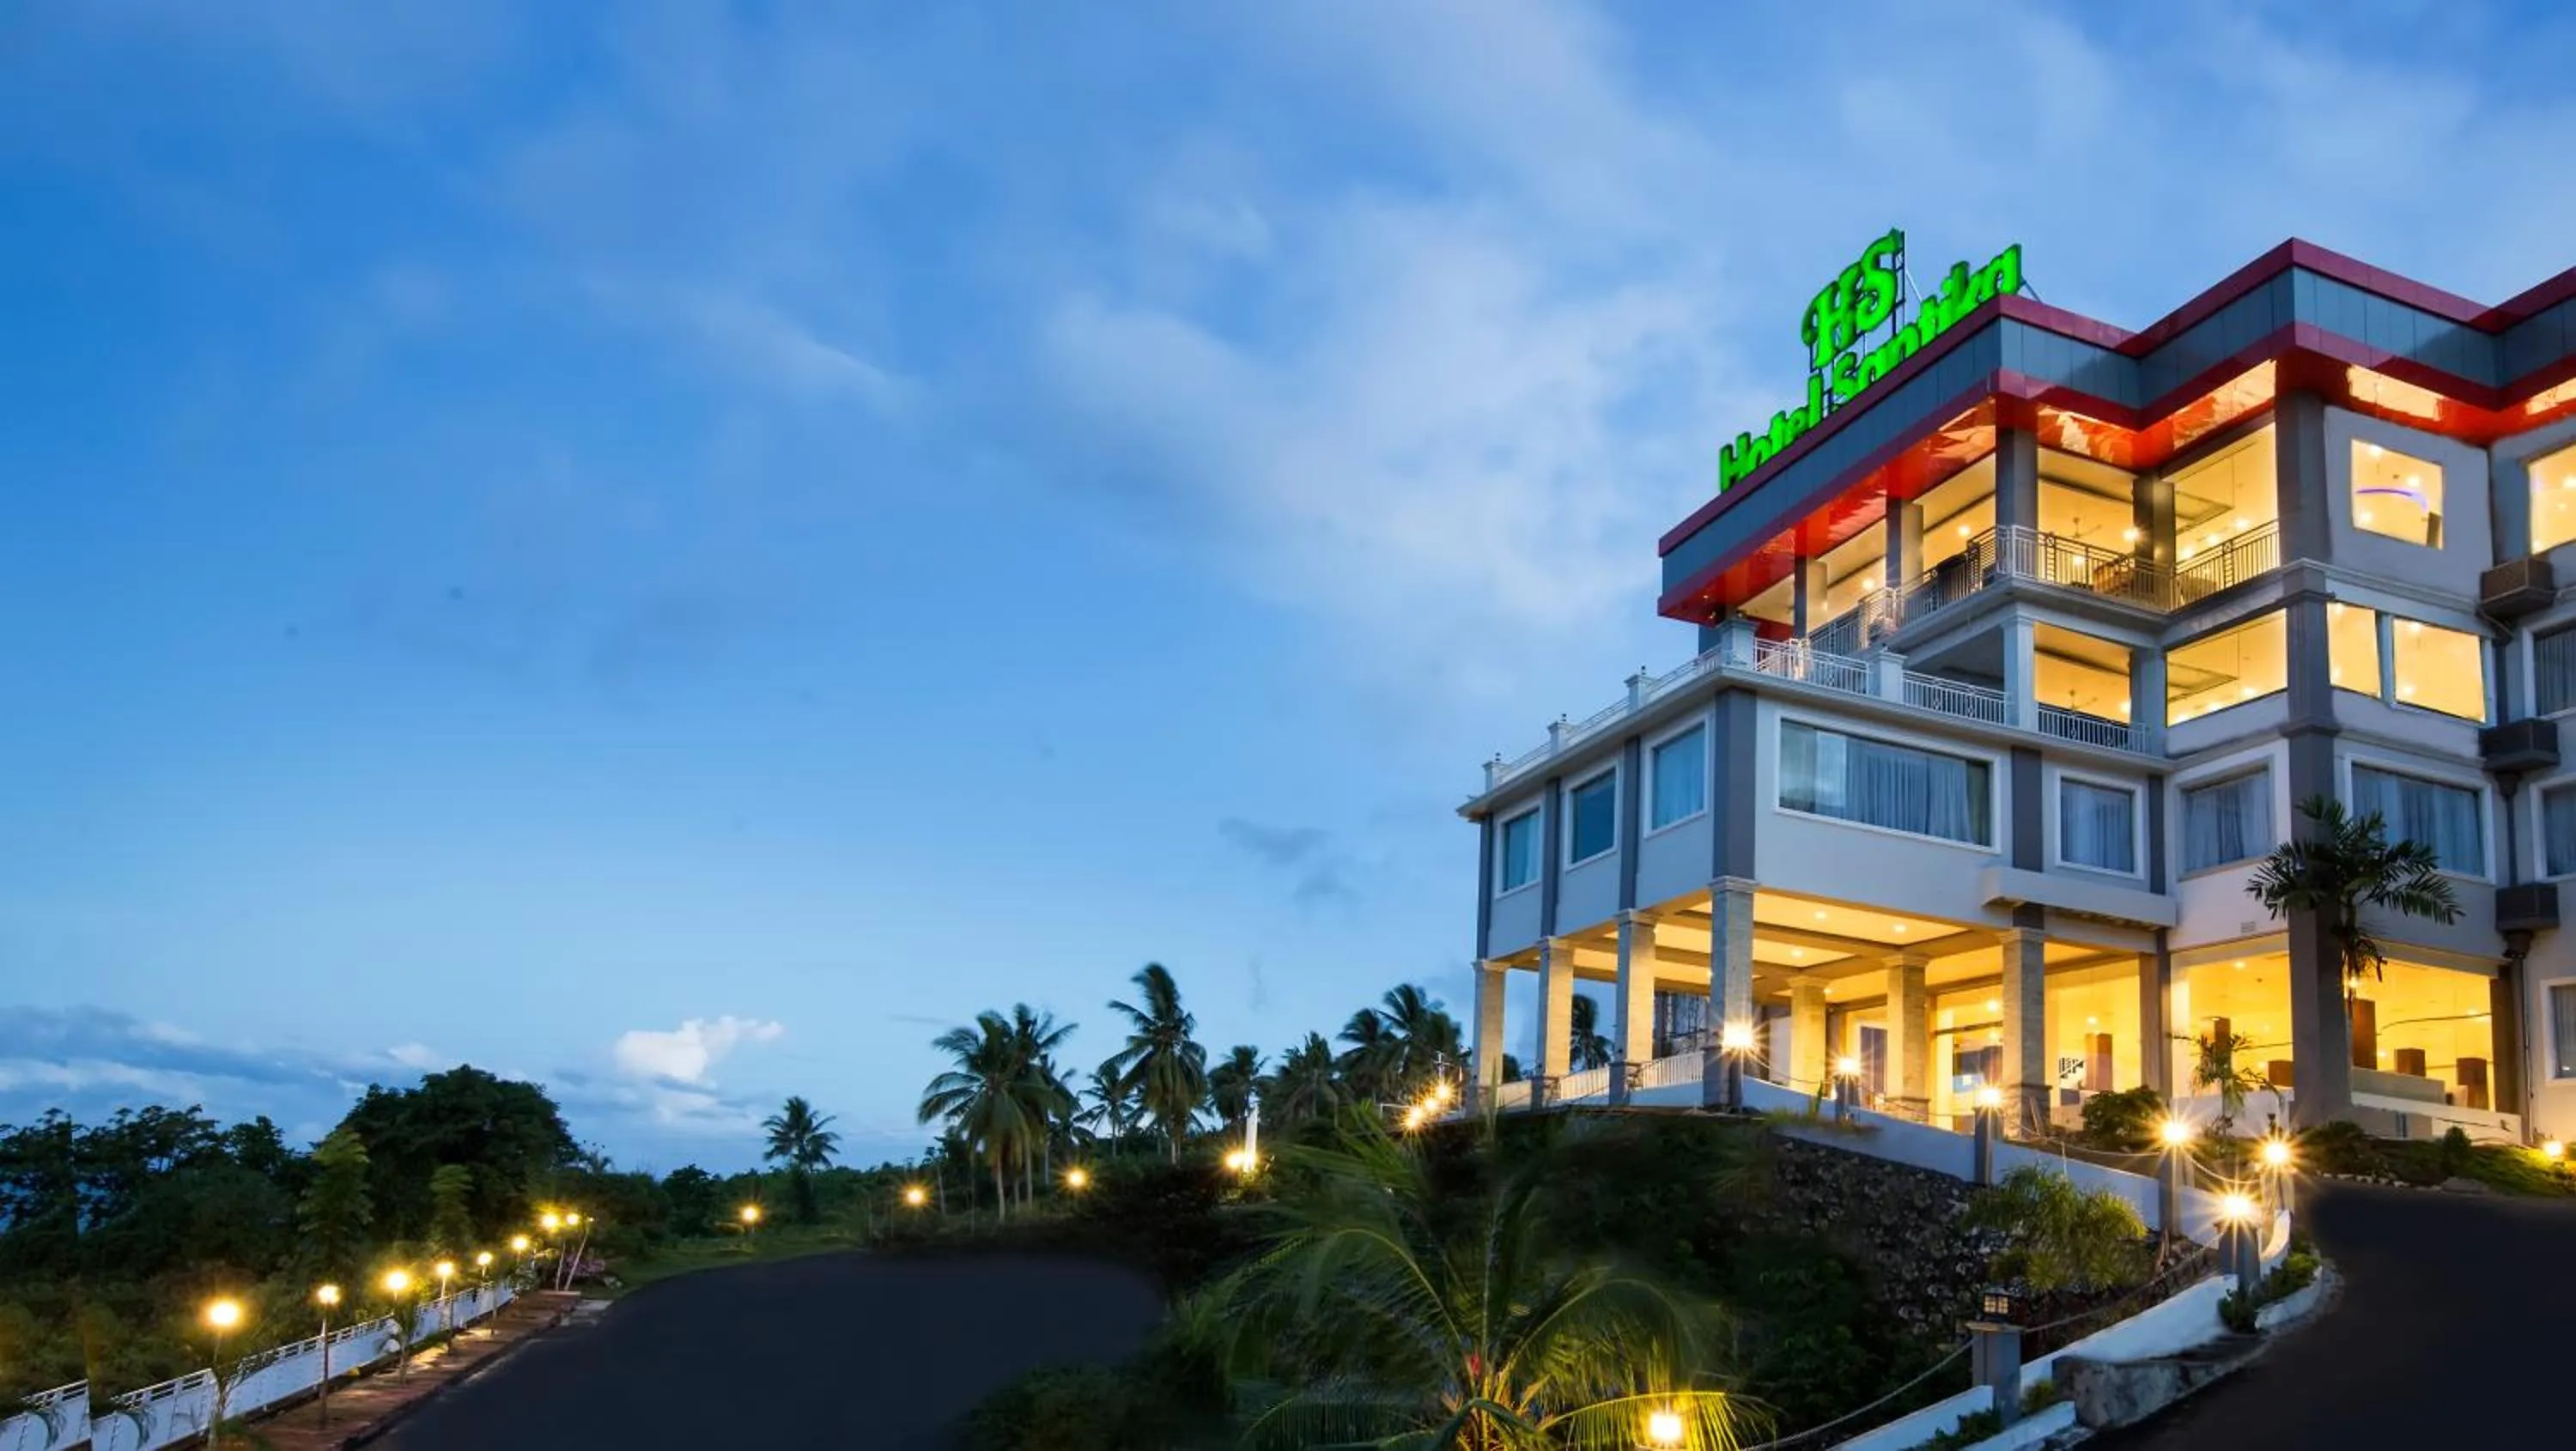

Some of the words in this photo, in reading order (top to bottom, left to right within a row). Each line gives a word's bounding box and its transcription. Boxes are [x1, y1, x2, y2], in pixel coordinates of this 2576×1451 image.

[1720, 373, 1823, 493] Hotel
[1831, 243, 2021, 411] Santika
[1801, 228, 1901, 368] HS
